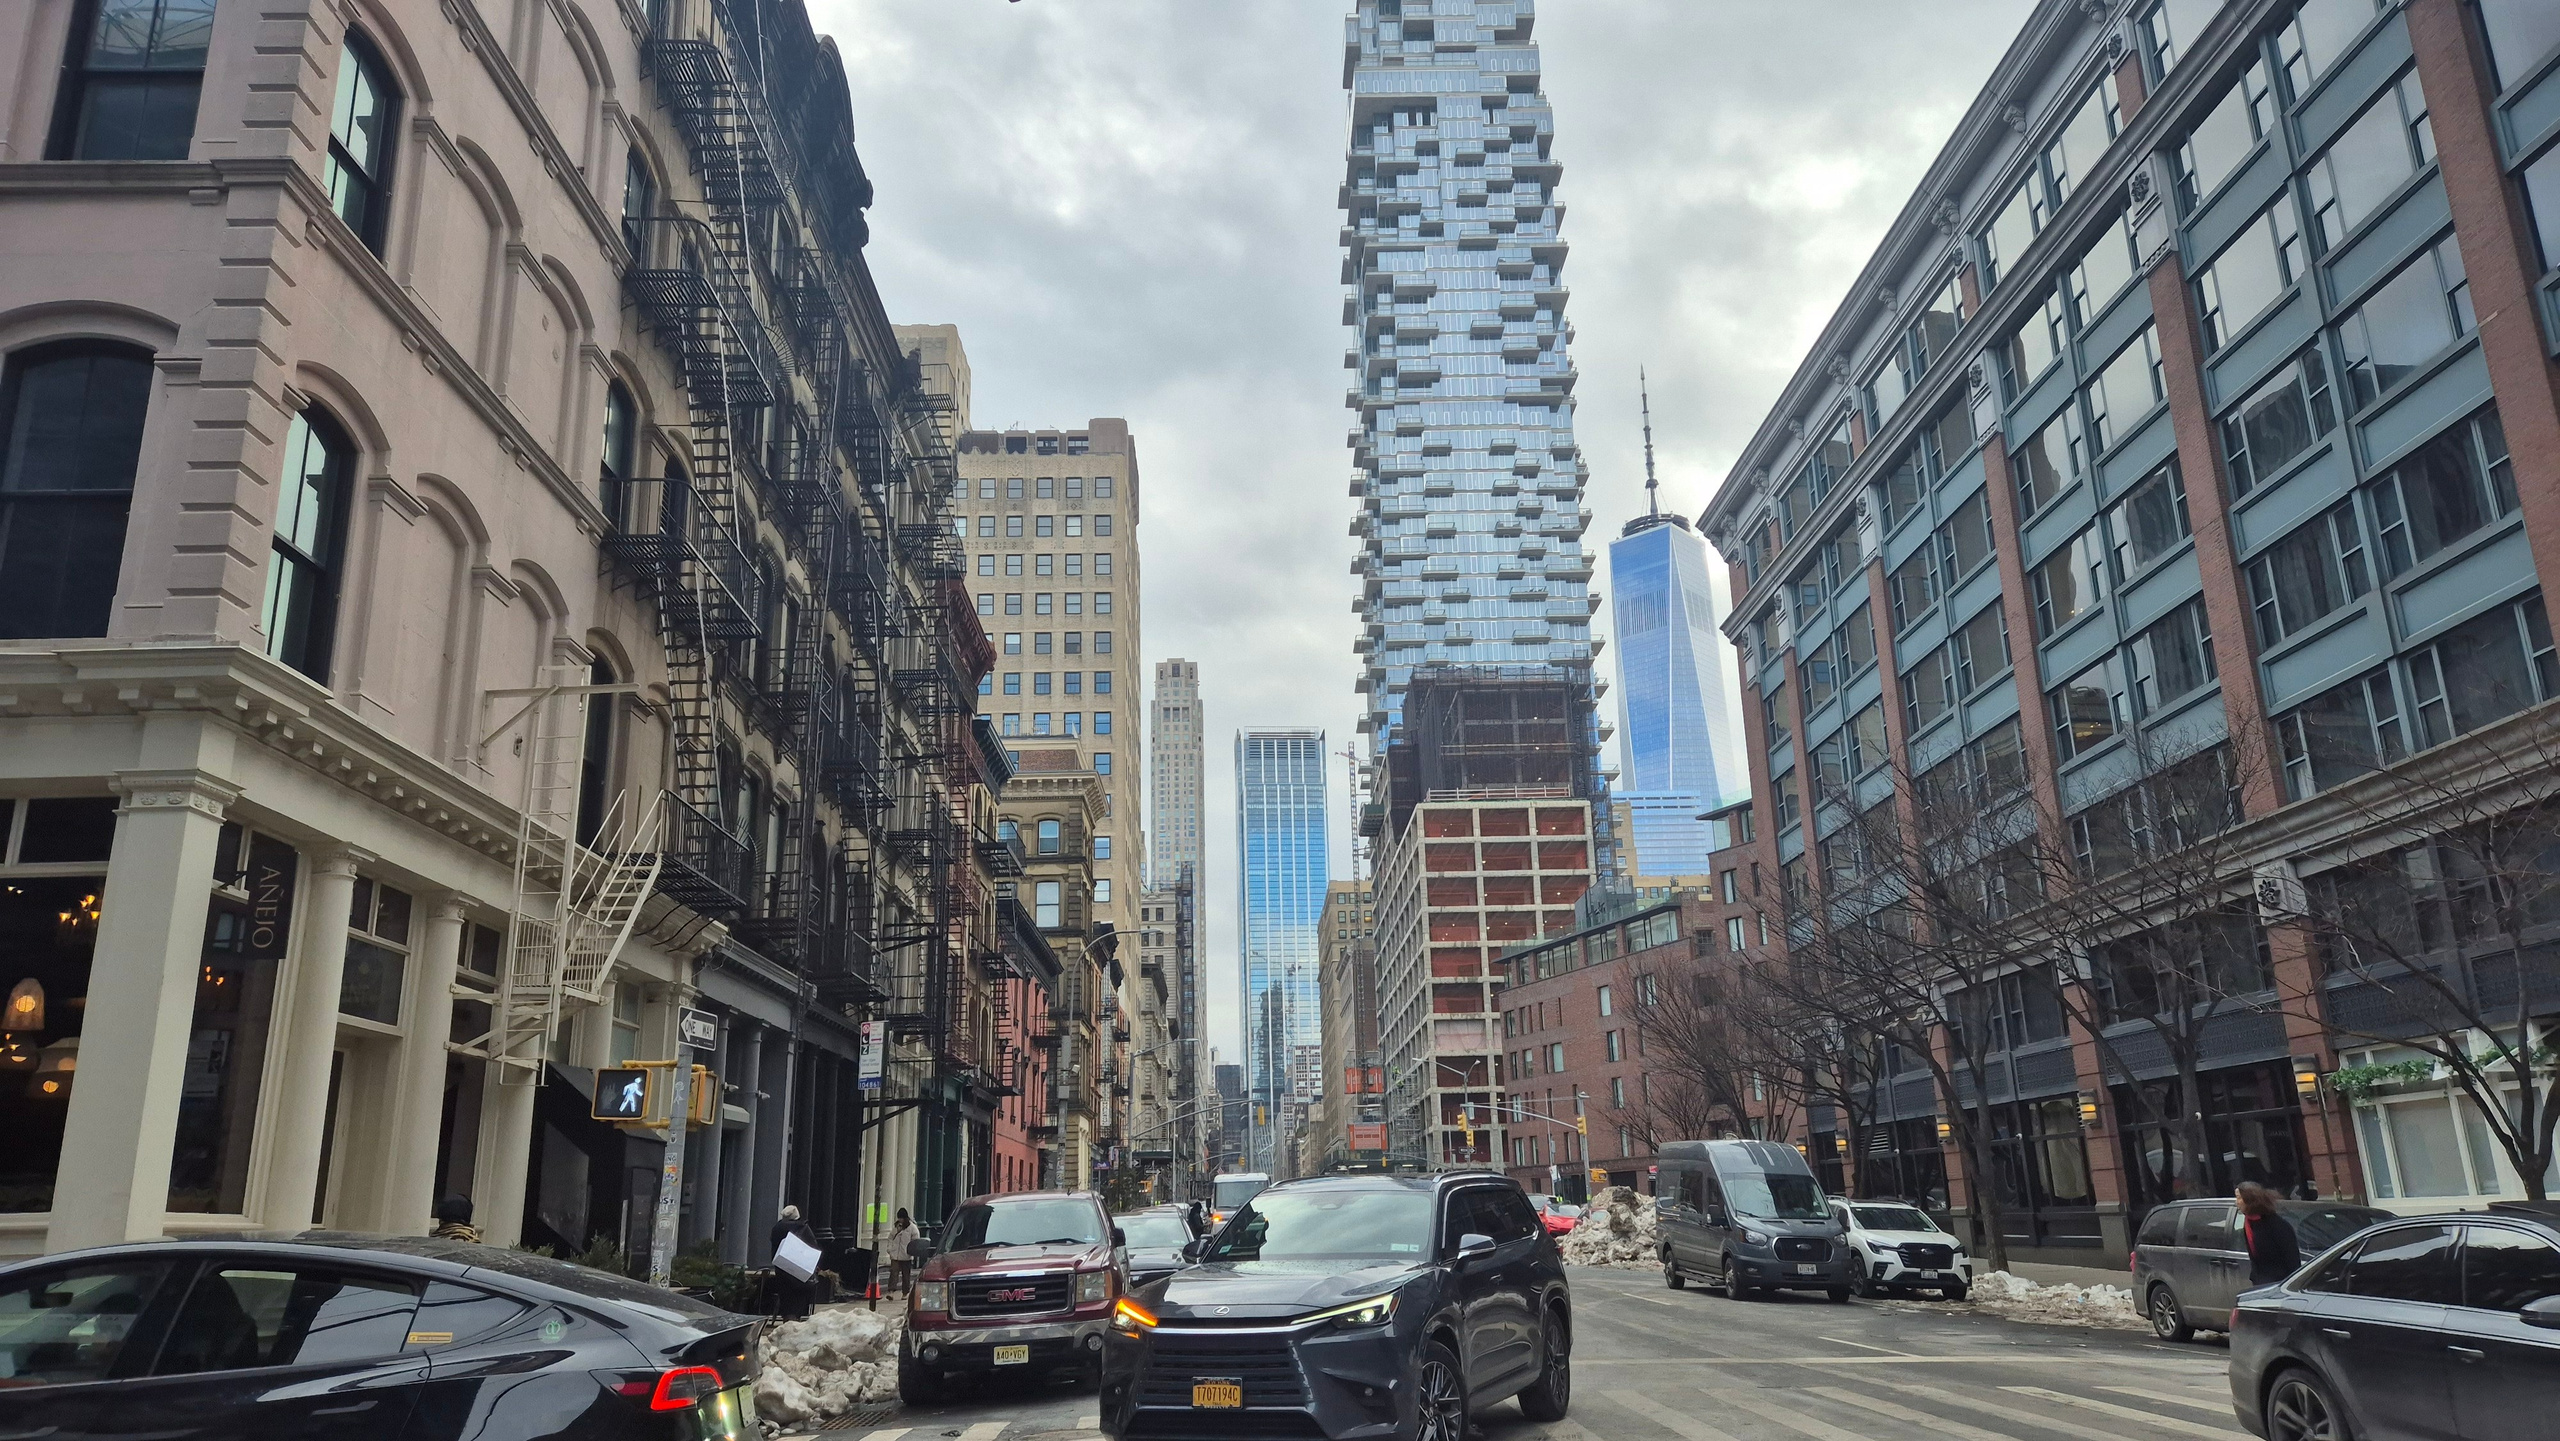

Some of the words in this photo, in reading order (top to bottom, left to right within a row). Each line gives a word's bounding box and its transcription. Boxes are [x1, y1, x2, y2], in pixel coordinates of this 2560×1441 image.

[252, 865, 285, 949] AÑEJO
[684, 1018, 696, 1035] ONE
[702, 1023, 714, 1039] WAY
[987, 1287, 1036, 1302] GMC
[1196, 1386, 1238, 1402] T707194C
